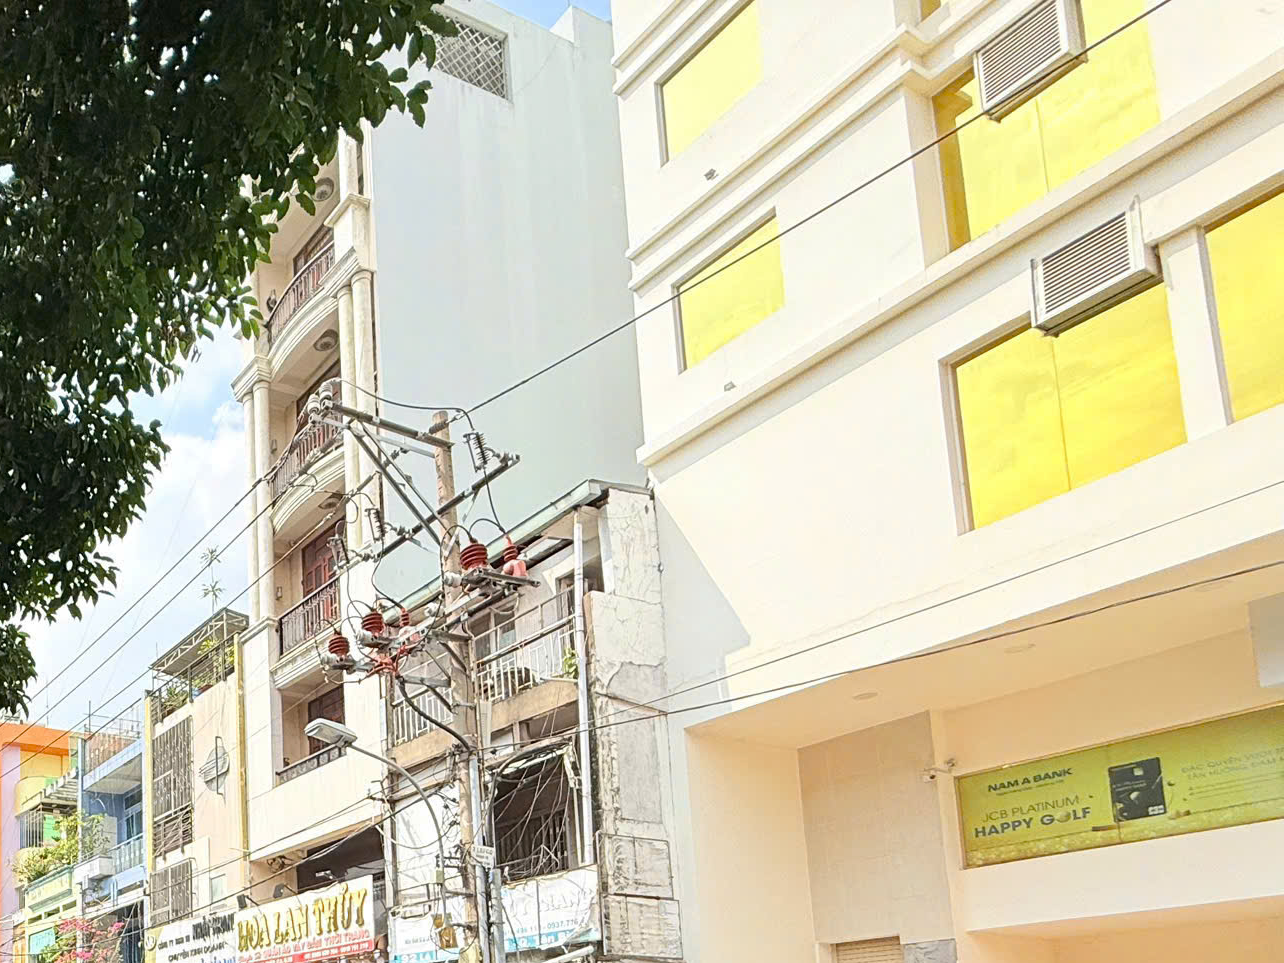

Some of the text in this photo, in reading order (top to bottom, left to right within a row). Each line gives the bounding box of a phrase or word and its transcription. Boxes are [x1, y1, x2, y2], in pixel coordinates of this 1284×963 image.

[987, 779, 1019, 792] NAM
[1021, 775, 1031, 785] A
[1033, 768, 1073, 783] BANK
[974, 807, 1092, 838] HAPPY GOLF
[982, 795, 1080, 823] JCB PLATINUM
